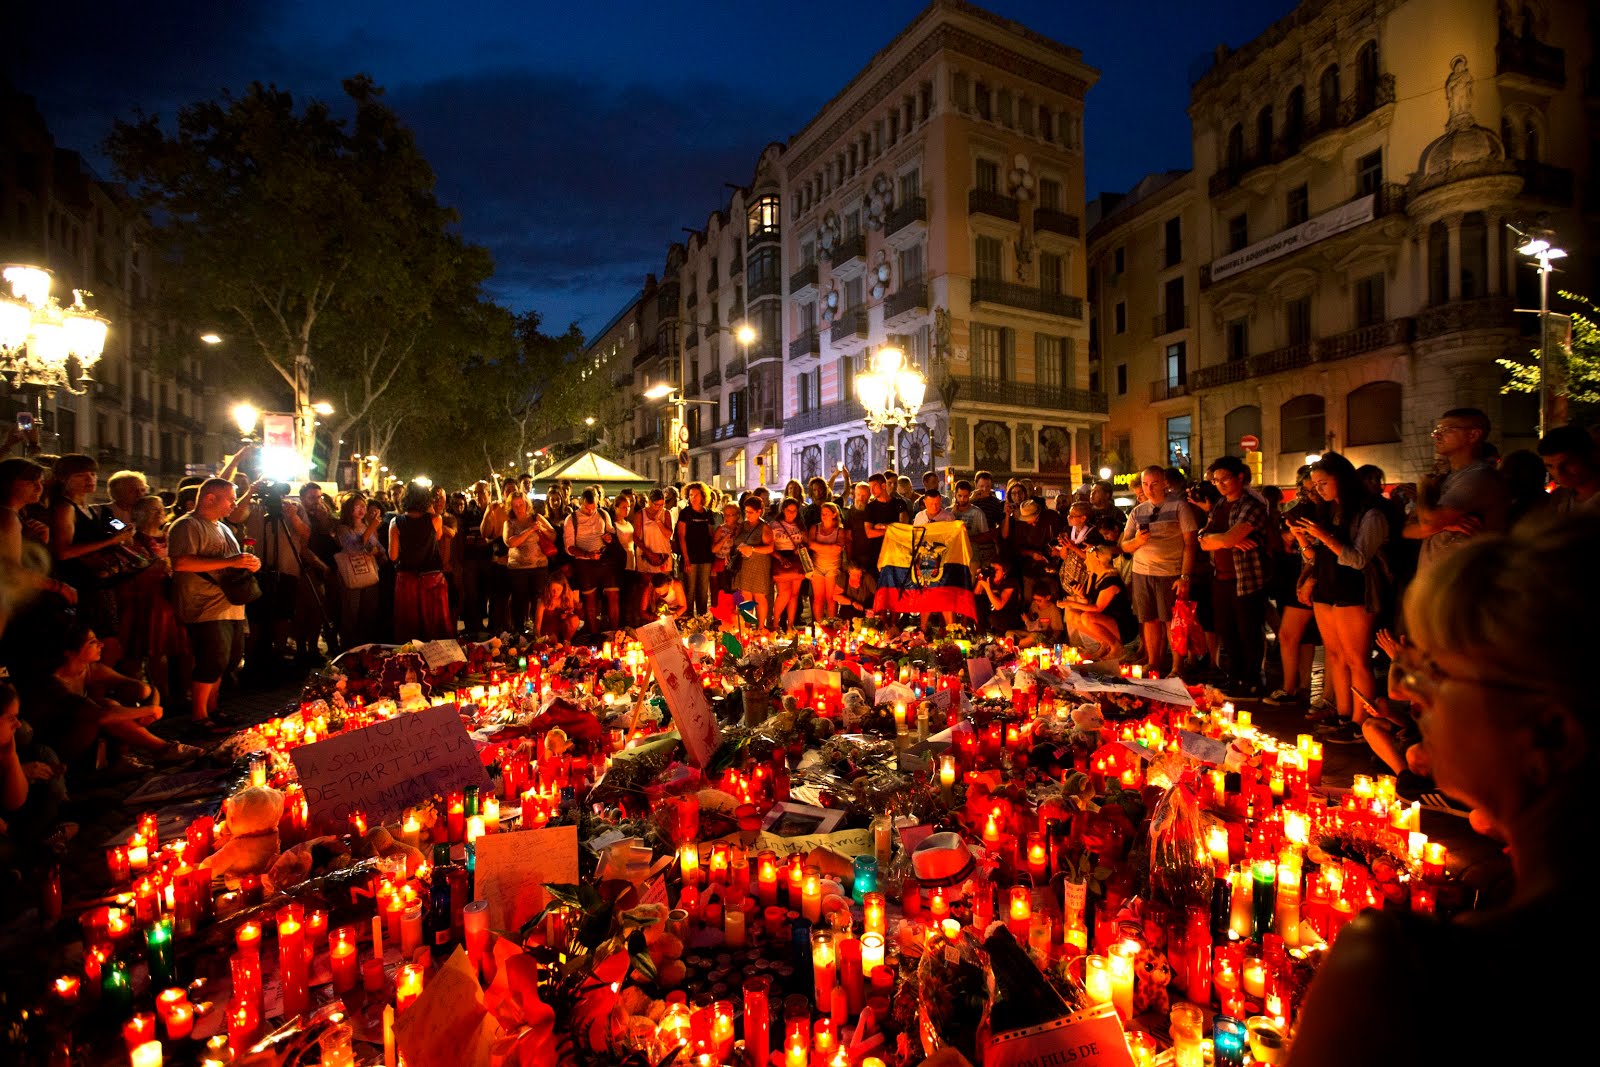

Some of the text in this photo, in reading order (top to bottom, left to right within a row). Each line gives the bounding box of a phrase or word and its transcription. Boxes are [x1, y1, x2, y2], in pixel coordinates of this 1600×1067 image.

[299, 719, 458, 780] LA SOLIDARITAT
[304, 735, 468, 807] DE PART DE LA
[439, 751, 481, 779] SIKH
[1079, 1042, 1100, 1058] DE
